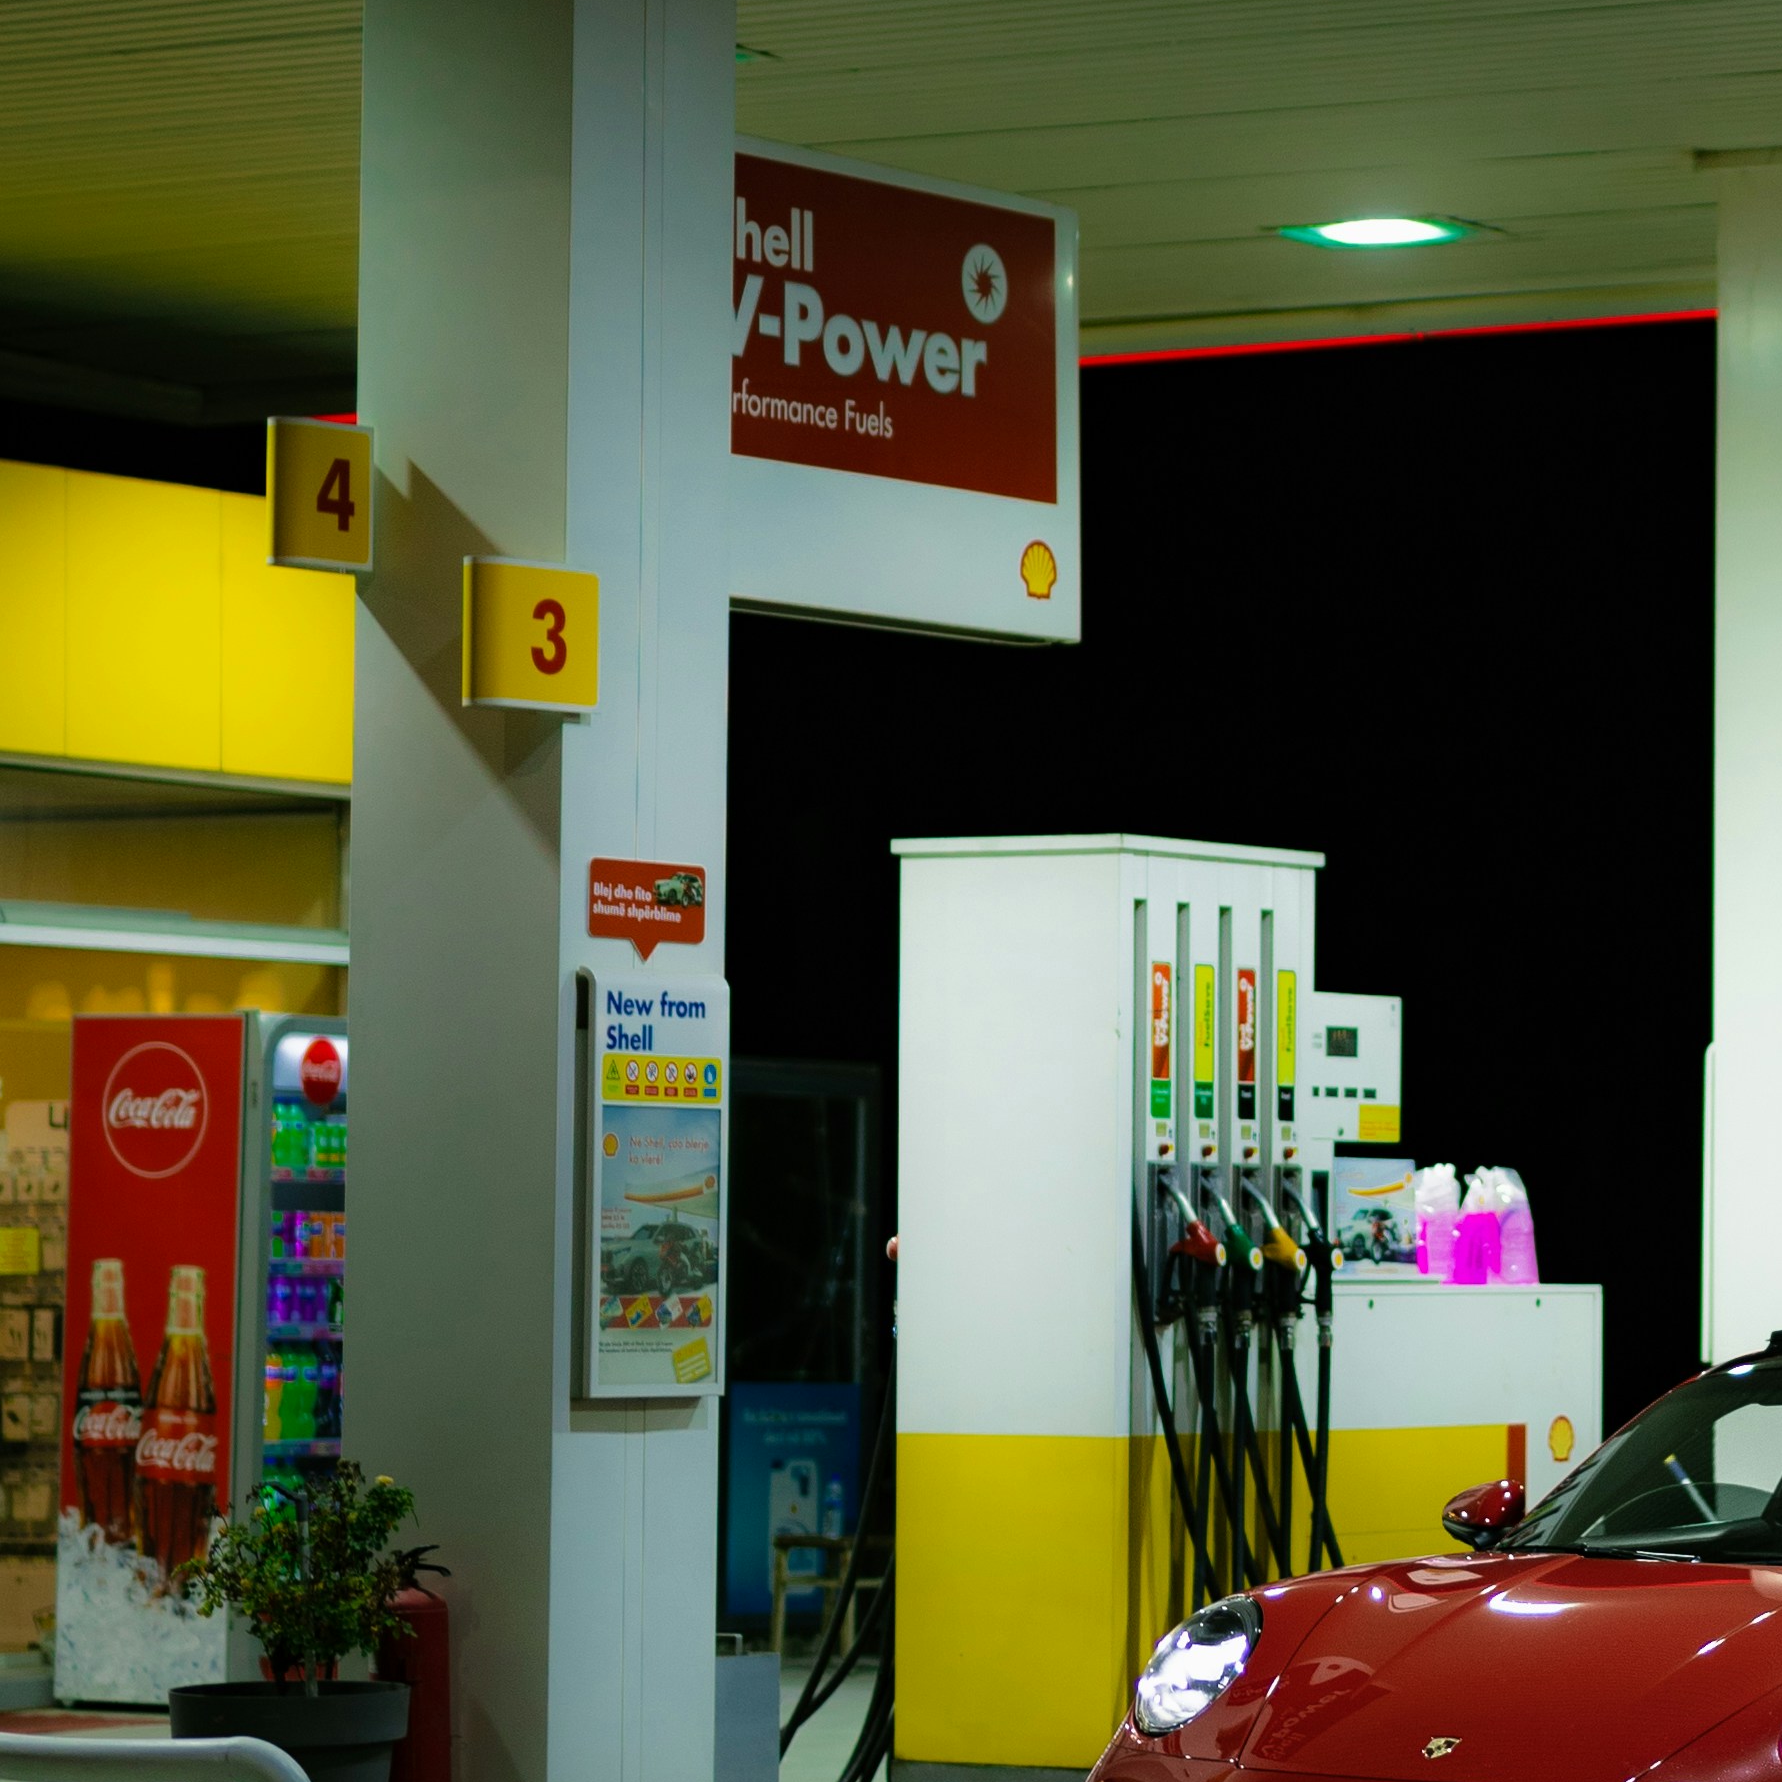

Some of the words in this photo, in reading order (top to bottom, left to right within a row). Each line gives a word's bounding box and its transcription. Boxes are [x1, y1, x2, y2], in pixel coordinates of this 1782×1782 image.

[735, 196, 814, 273] hell
[731, 273, 988, 398] V-Power
[733, 377, 838, 429] rformance
[844, 399, 894, 439] Fuels
[316, 458, 355, 532] 4
[530, 598, 567, 675] 3
[593, 881, 612, 902] Blej
[635, 886, 652, 902] fito
[593, 899, 625, 916] shumë
[627, 903, 681, 923] shpërblime
[606, 990, 653, 1016] New
[660, 990, 706, 1018] from
[606, 1023, 653, 1051] Shell
[109, 1087, 200, 1129] Coca-Cola
[135, 1427, 219, 1473] Coca-Cola
